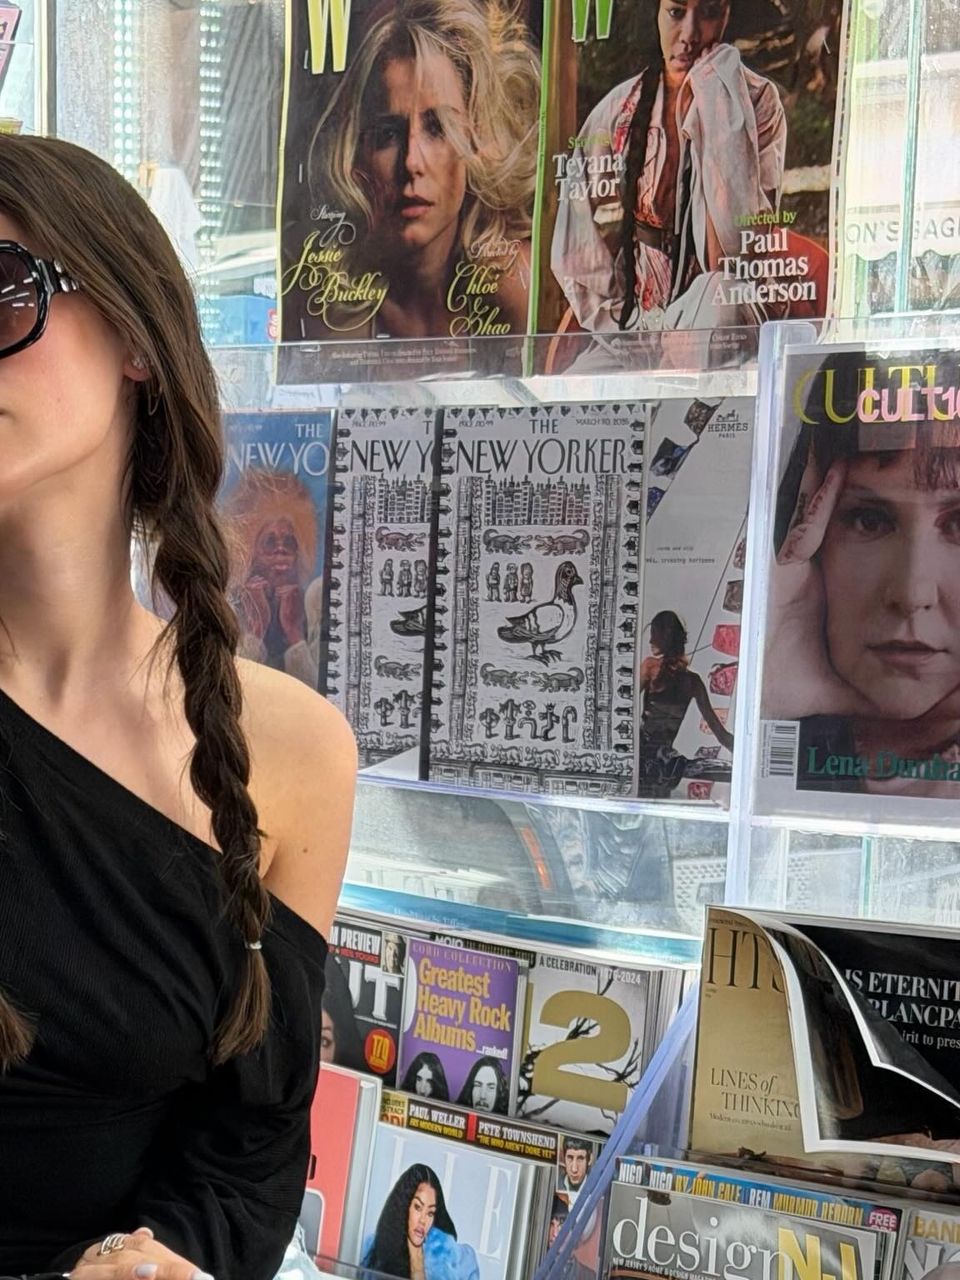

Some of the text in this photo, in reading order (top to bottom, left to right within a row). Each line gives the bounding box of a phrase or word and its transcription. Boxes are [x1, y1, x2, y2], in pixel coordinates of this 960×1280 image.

[552, 151, 625, 180] Teyana
[555, 176, 622, 202] Taylor
[782, 209, 797, 227] by
[740, 229, 789, 256] Paul
[718, 254, 809, 282] Thomas
[306, 271, 389, 331] Buckley
[711, 278, 816, 307] Anderson
[295, 423, 324, 438] THE
[529, 418, 559, 434] THE
[290, 441, 331, 477] YO
[351, 439, 411, 473] NEW
[456, 438, 628, 475] NEW YORKER
[340, 926, 381, 955] PREVIEW
[419, 957, 491, 999] Greatest
[539, 956, 598, 977] A CELEBRATION
[417, 985, 512, 1032] Heavy Rock
[413, 1012, 477, 1053] Albums
[532, 989, 632, 1114] 2
[710, 1066, 778, 1095] LINES of
[409, 1104, 466, 1128] PAUL WELLER
[478, 1121, 556, 1150] PETE TOWNSHEND
[618, 1162, 644, 1187] NICO
[649, 1169, 673, 1191] NICO
[676, 1174, 689, 1193] BY
[690, 1175, 715, 1198] JOHN
[749, 1187, 771, 1208] REM
[773, 1191, 818, 1218] MURMUR
[869, 1211, 898, 1228] FREE
